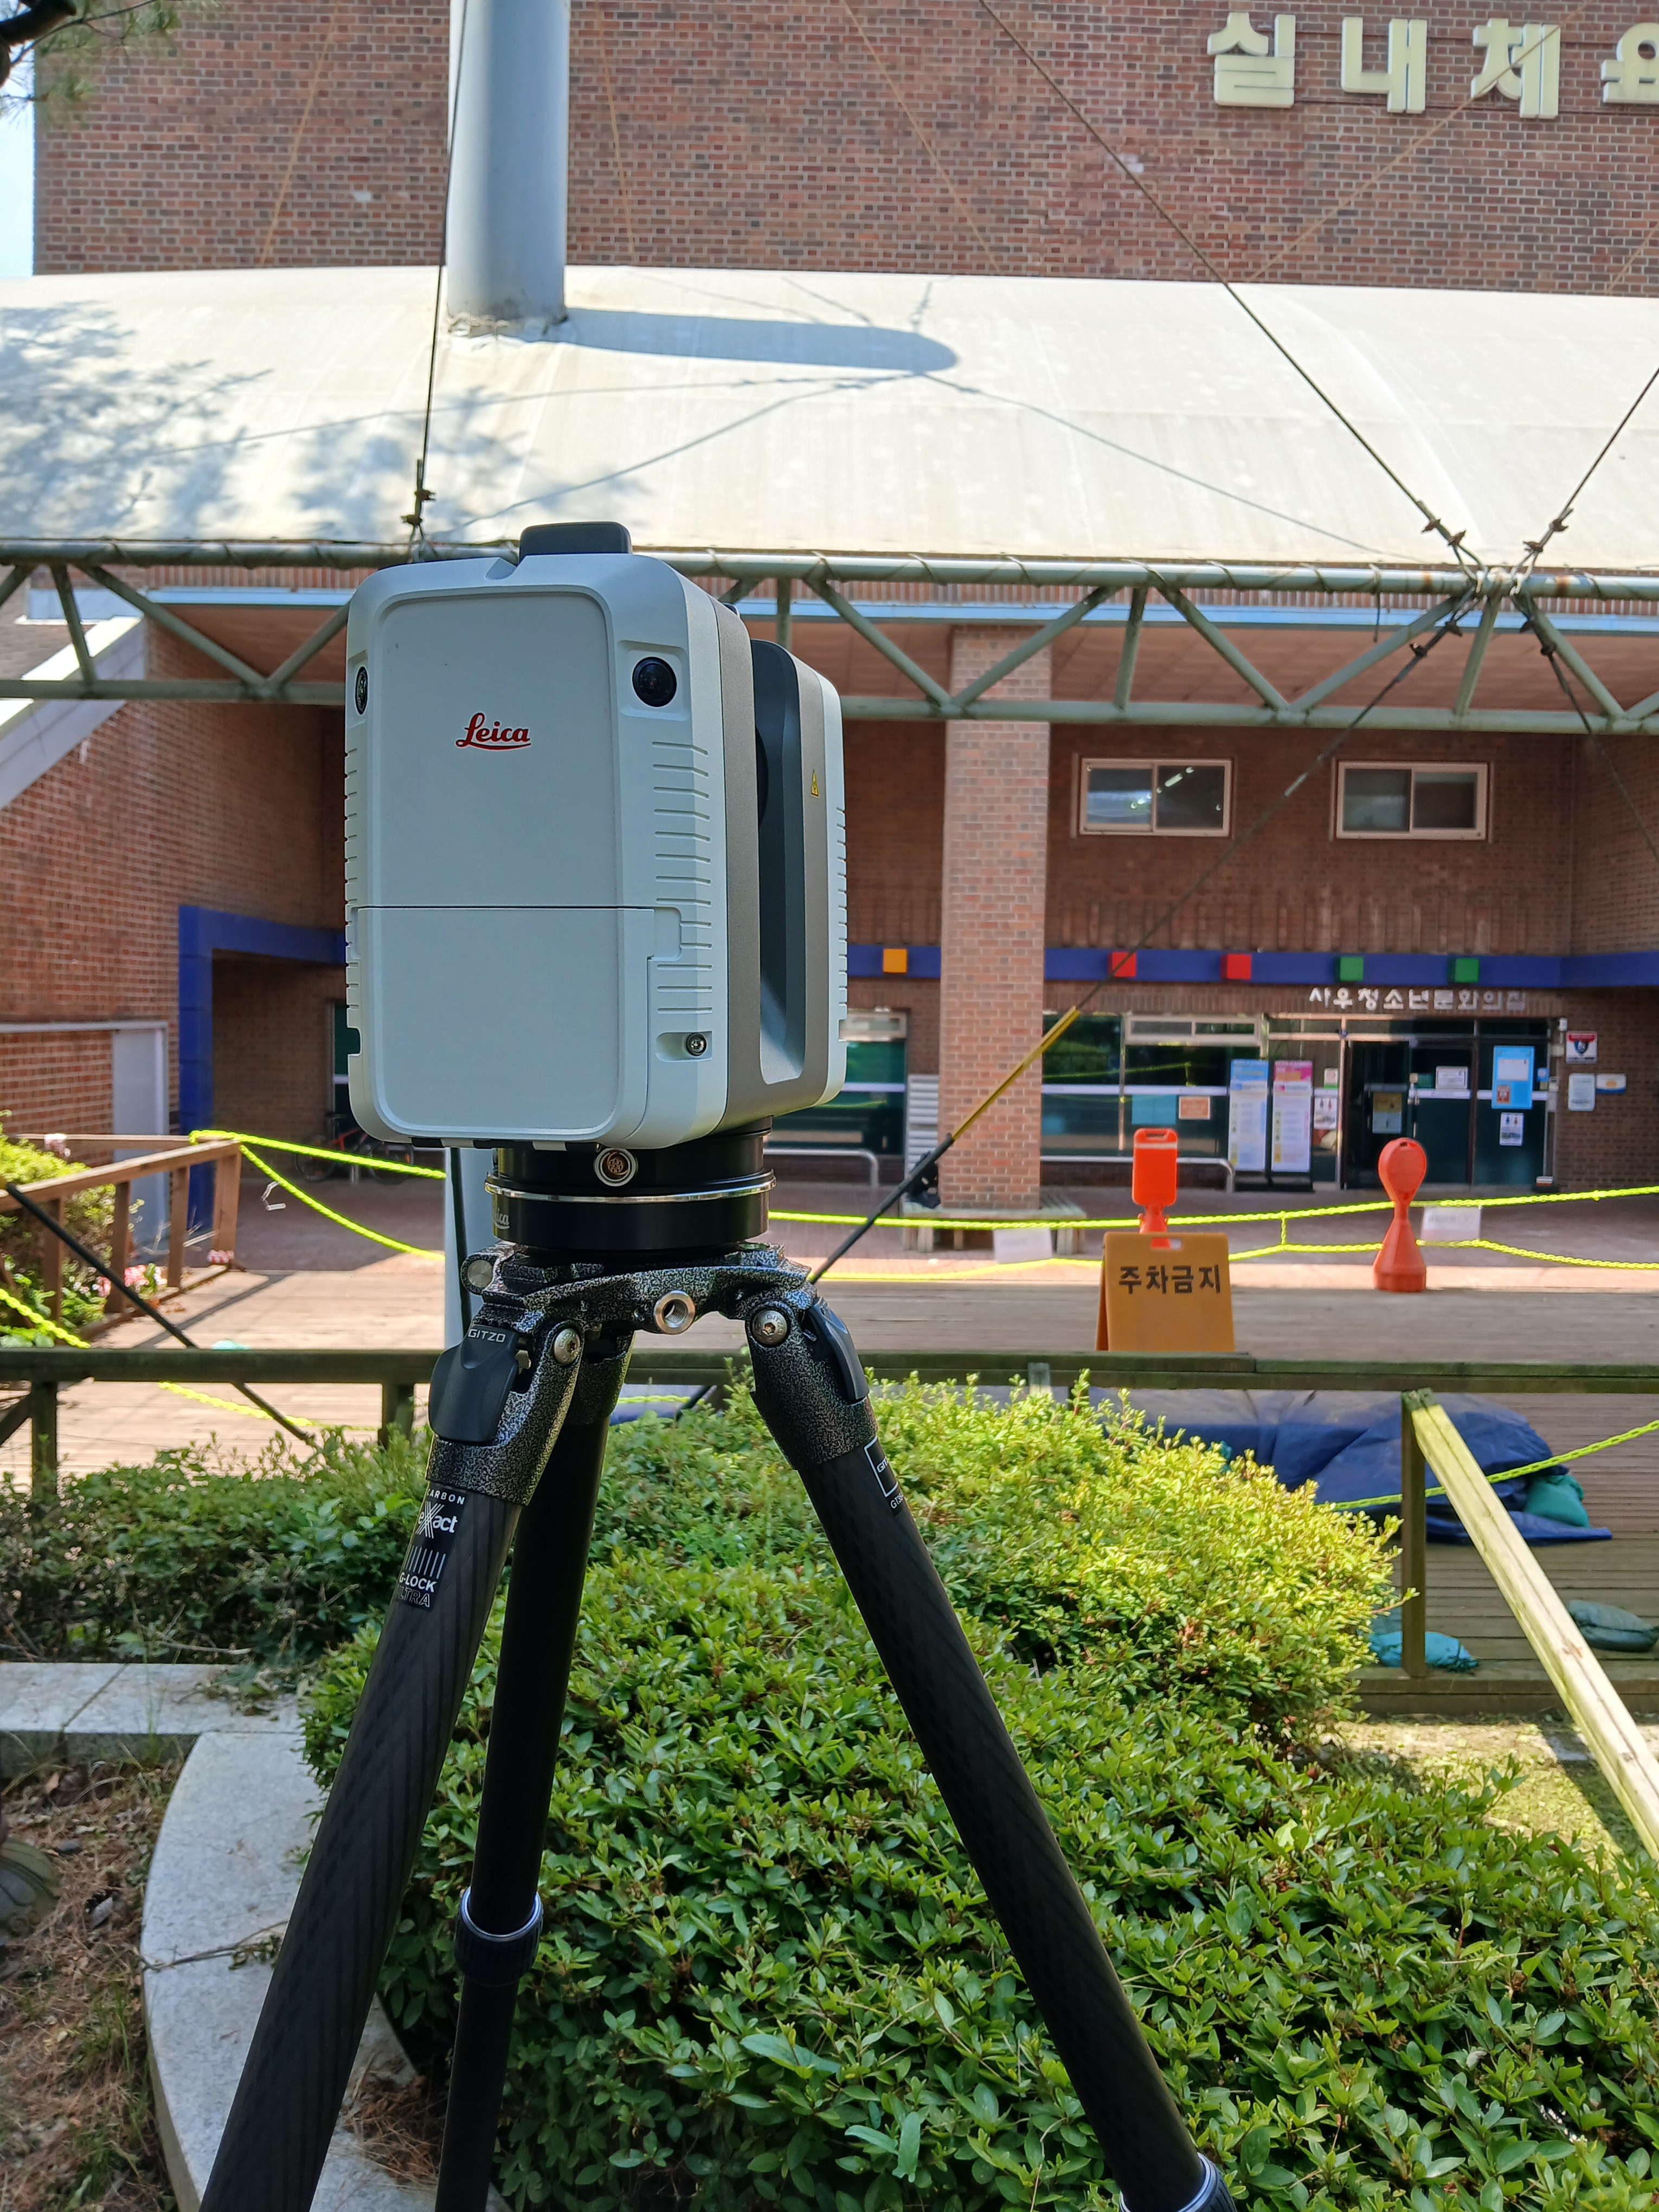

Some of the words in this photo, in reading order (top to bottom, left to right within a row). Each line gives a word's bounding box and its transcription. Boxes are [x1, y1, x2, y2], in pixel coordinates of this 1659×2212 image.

[456, 712, 531, 750] Leica
[1118, 1264, 1220, 1294] 주차금지
[468, 1329, 506, 1343] GITZO
[877, 1456, 889, 1473] GIT
[427, 1488, 465, 1505] CARBON
[415, 1501, 458, 1539] eXact
